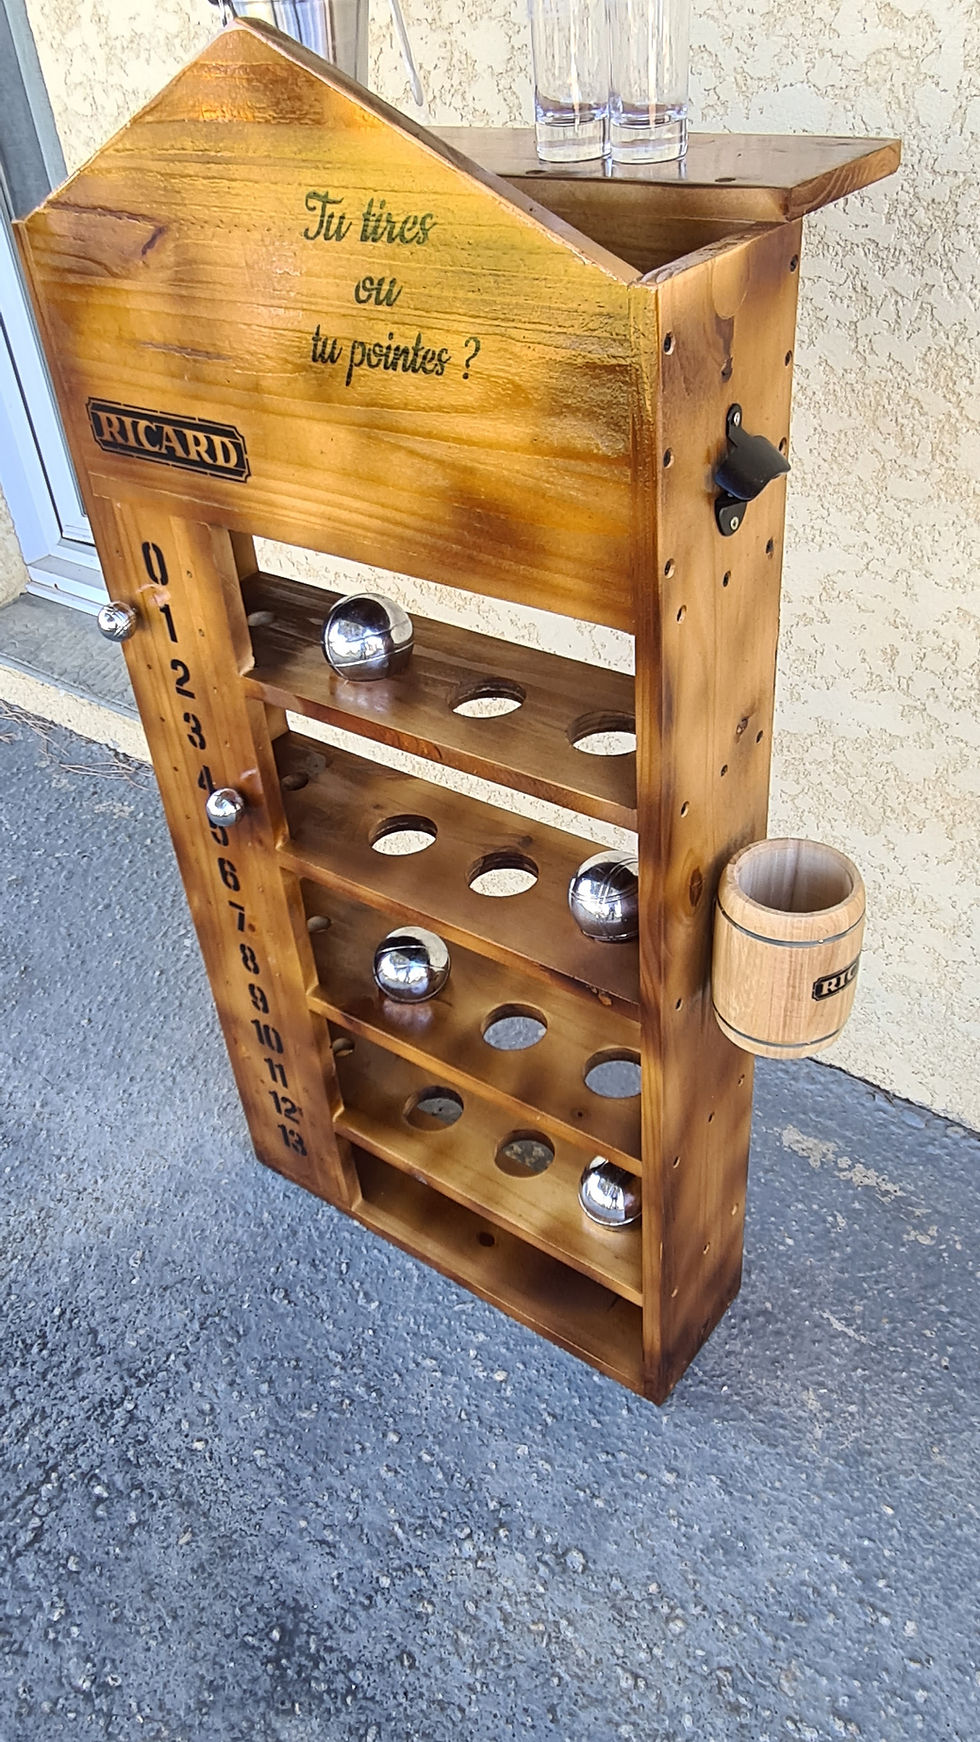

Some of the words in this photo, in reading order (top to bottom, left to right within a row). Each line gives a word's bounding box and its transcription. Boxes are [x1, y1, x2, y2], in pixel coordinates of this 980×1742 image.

[303, 190, 353, 242] Tu
[360, 198, 438, 245] tires
[354, 275, 403, 307] ou
[311, 324, 343, 364] tu
[345, 331, 451, 387] pointes
[462, 336, 481, 380] ?
[97, 411, 239, 469] RICARD
[141, 541, 169, 586] 0
[160, 604, 178, 643] 1
[170, 659, 196, 699] 2
[183, 712, 206, 750] 3
[217, 857, 240, 892] 6
[228, 900, 245, 932] 7
[239, 943, 260, 975] 8
[248, 983, 269, 1014] 9
[251, 1019, 284, 1054] 10
[264, 1058, 288, 1089] 11
[269, 1090, 301, 1124] 12
[277, 1123, 307, 1157] 13
